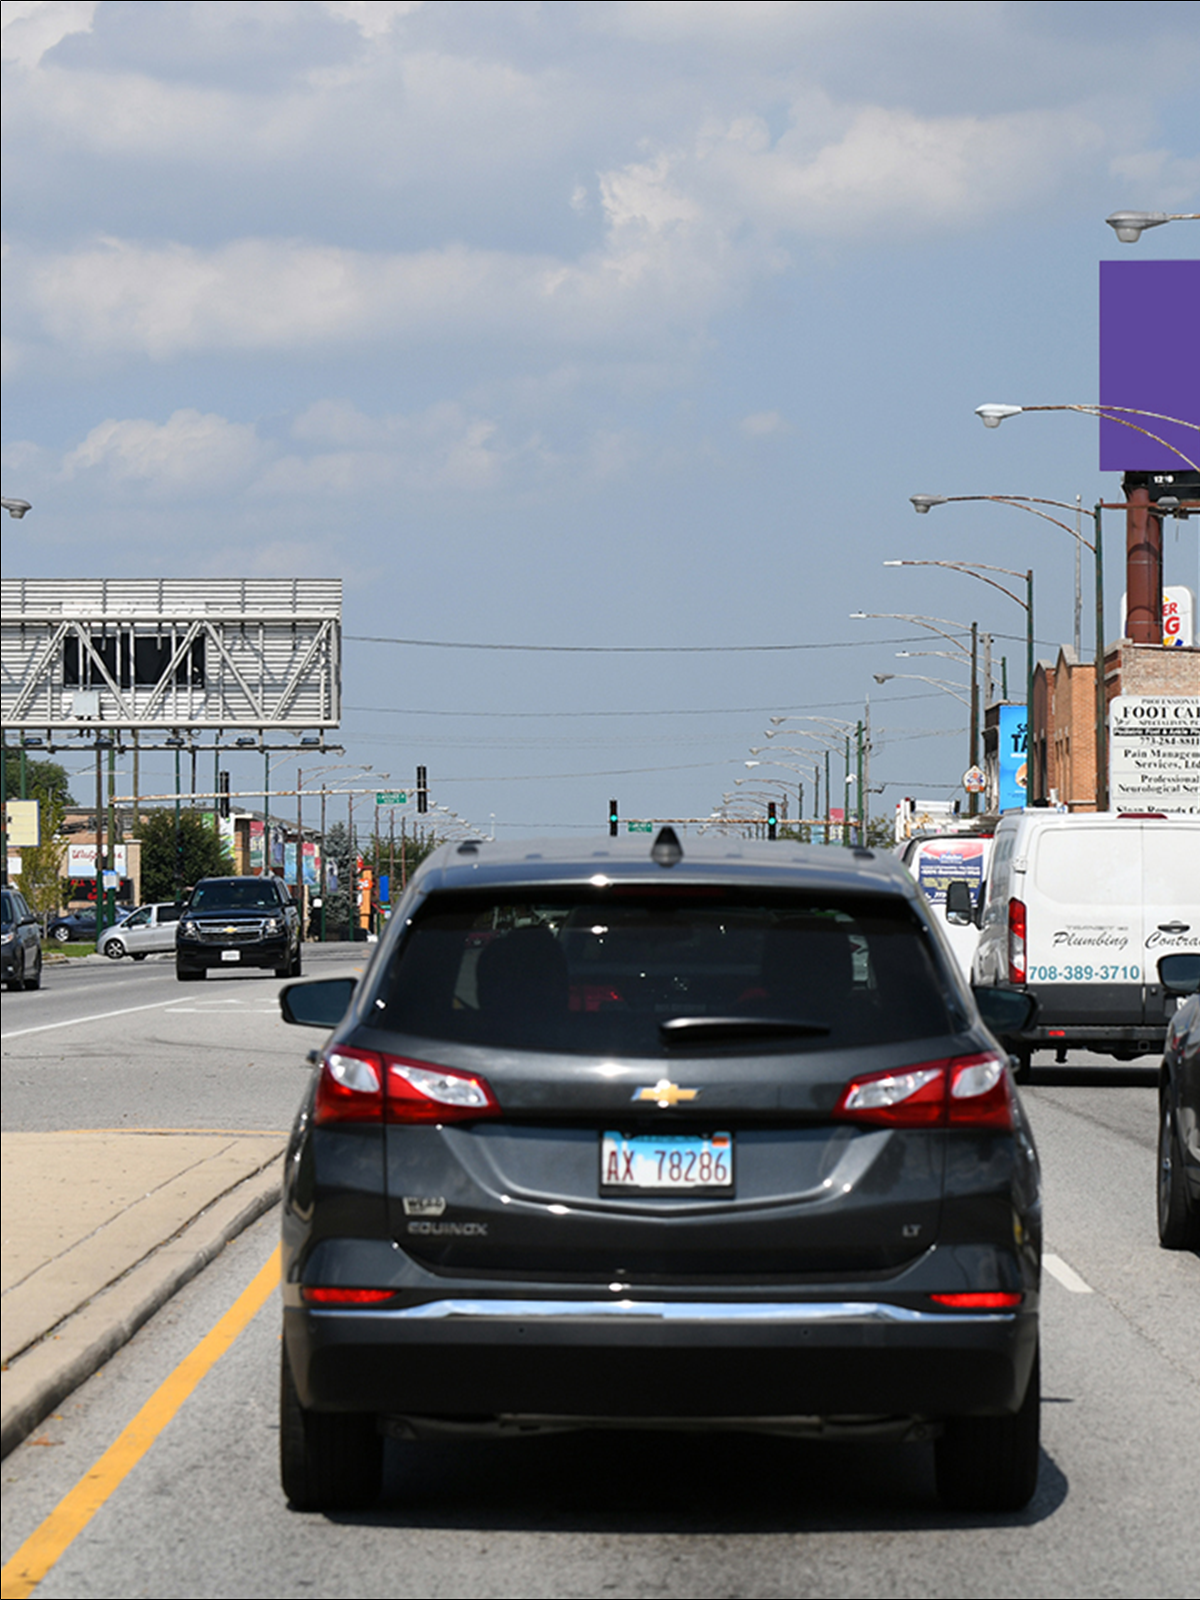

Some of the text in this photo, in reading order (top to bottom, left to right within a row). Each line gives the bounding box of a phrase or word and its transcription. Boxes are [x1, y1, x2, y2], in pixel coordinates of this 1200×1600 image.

[1123, 706, 1167, 719] FOOT
[1123, 749, 1147, 758] Pain
[1140, 774, 1200, 783] Professional
[1118, 784, 1181, 794] Neurological
[1052, 931, 1128, 950] Plumbing
[1028, 965, 1140, 980] 708-389-3710
[607, 1149, 727, 1182] AX 78286
[407, 1222, 488, 1236] EQUINOX
[902, 1224, 922, 1237] LT
